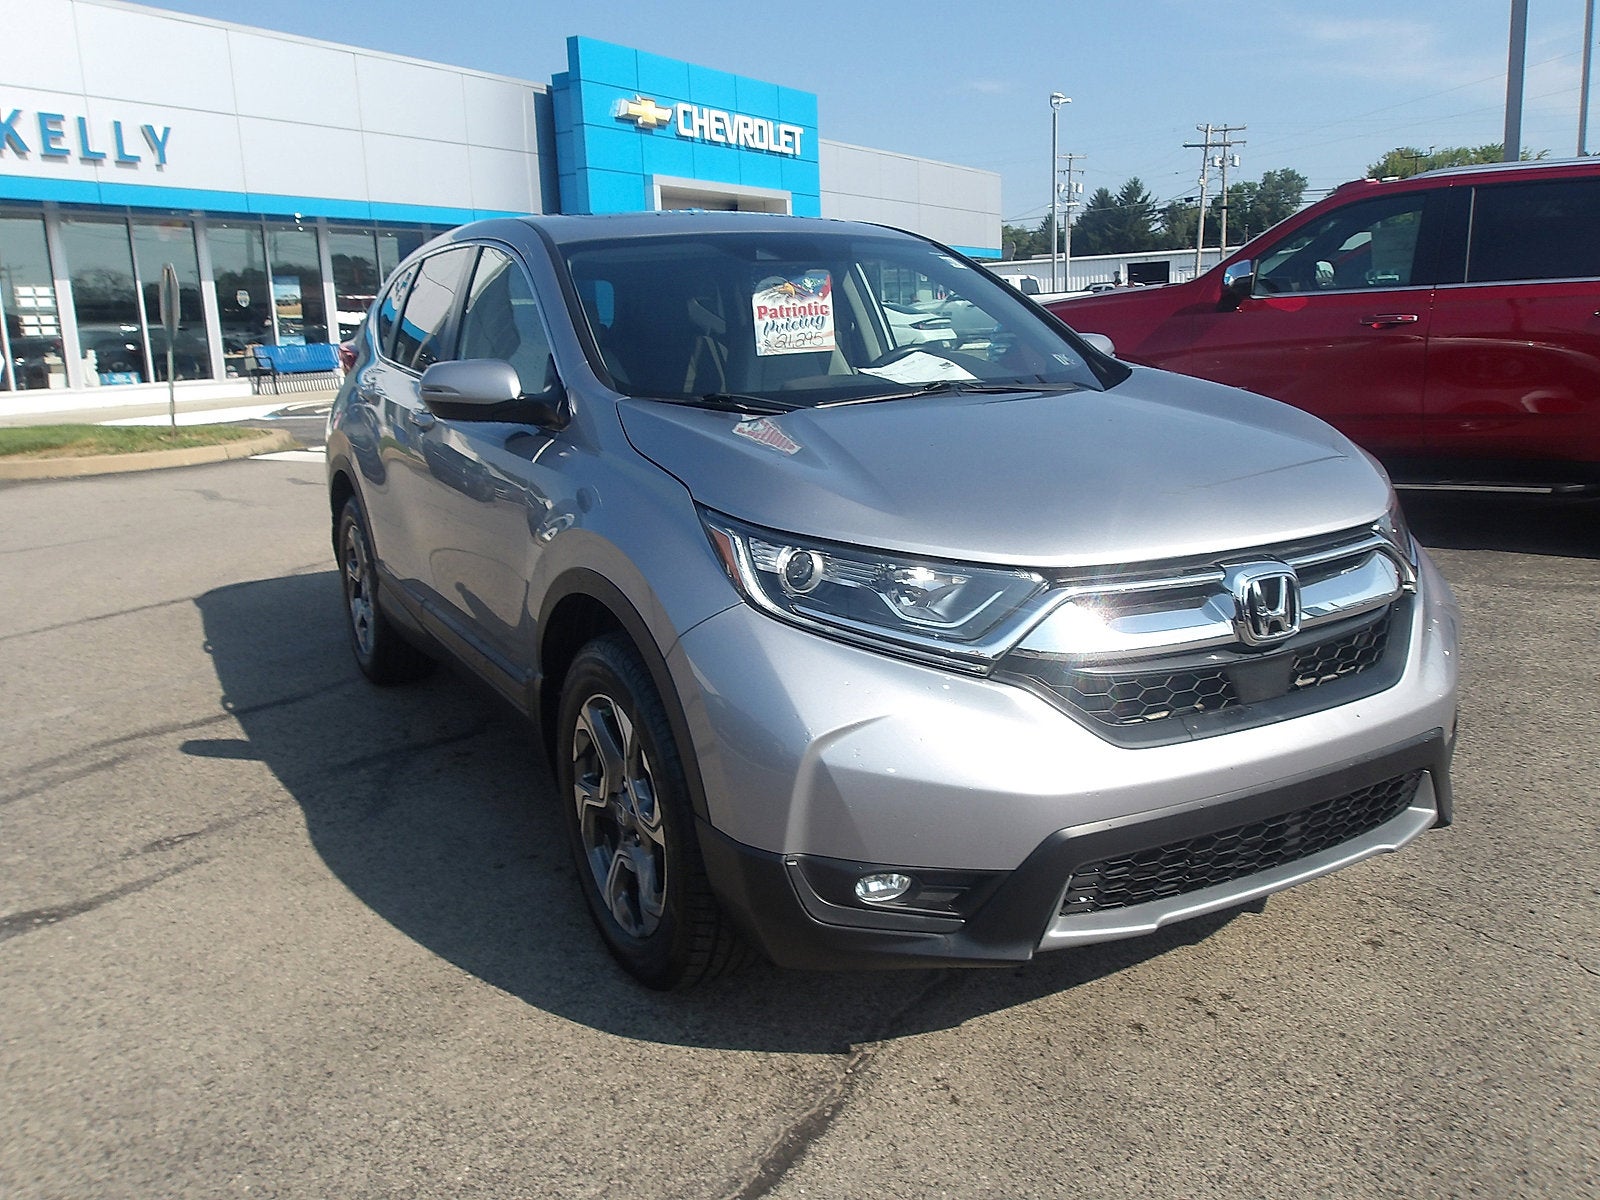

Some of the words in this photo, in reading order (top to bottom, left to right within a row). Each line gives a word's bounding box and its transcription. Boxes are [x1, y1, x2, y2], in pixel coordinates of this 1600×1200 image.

[0, 107, 171, 165] KELLY
[676, 102, 804, 156] CHEVROLET
[757, 302, 829, 320] Patriotic
